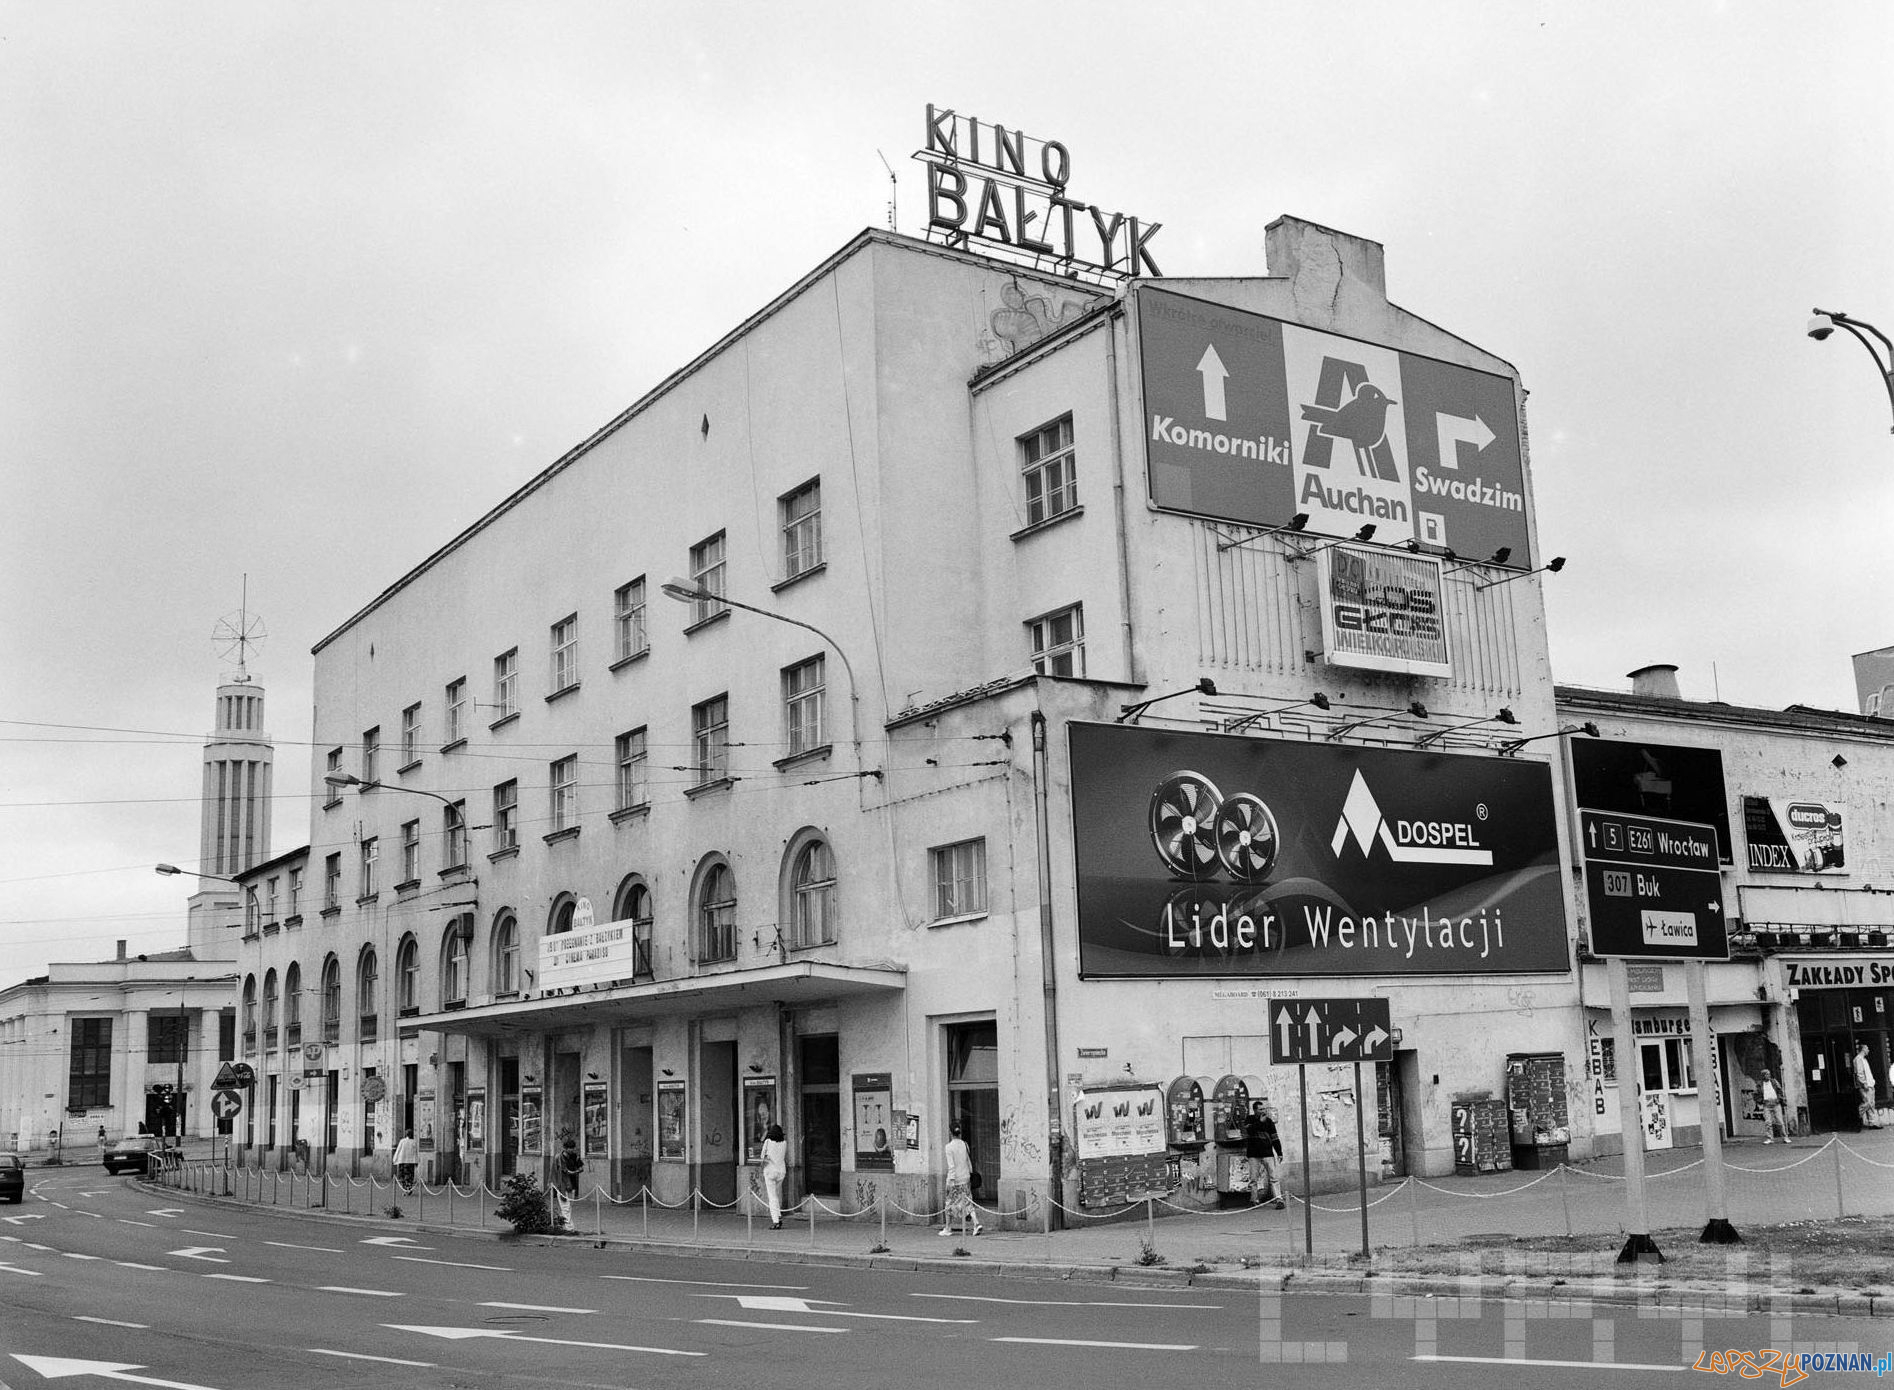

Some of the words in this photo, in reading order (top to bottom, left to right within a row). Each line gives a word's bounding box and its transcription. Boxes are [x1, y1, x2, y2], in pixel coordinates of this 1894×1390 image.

[925, 102, 1070, 188] KINO
[926, 159, 1163, 277] BAŁTYK
[1151, 414, 1292, 466] Komorniki
[1300, 472, 1408, 523] Auchan
[1414, 465, 1523, 513] Swadzim
[1397, 819, 1480, 847] DOSPEL
[1791, 808, 1825, 823] ducros
[1609, 829, 1617, 845] 5
[1629, 830, 1653, 851] E261
[1657, 832, 1710, 858] Wrocław
[1749, 843, 1792, 868] INDEX
[1607, 873, 1628, 893] 307
[1637, 875, 1661, 898] Buk
[1166, 902, 1275, 948] Lider
[1303, 904, 1503, 958] Wentylacji
[1660, 920, 1694, 938] Ławica
[1786, 963, 1864, 986] ZAKŁADY
[1588, 1019, 1605, 1115] KEBAB
